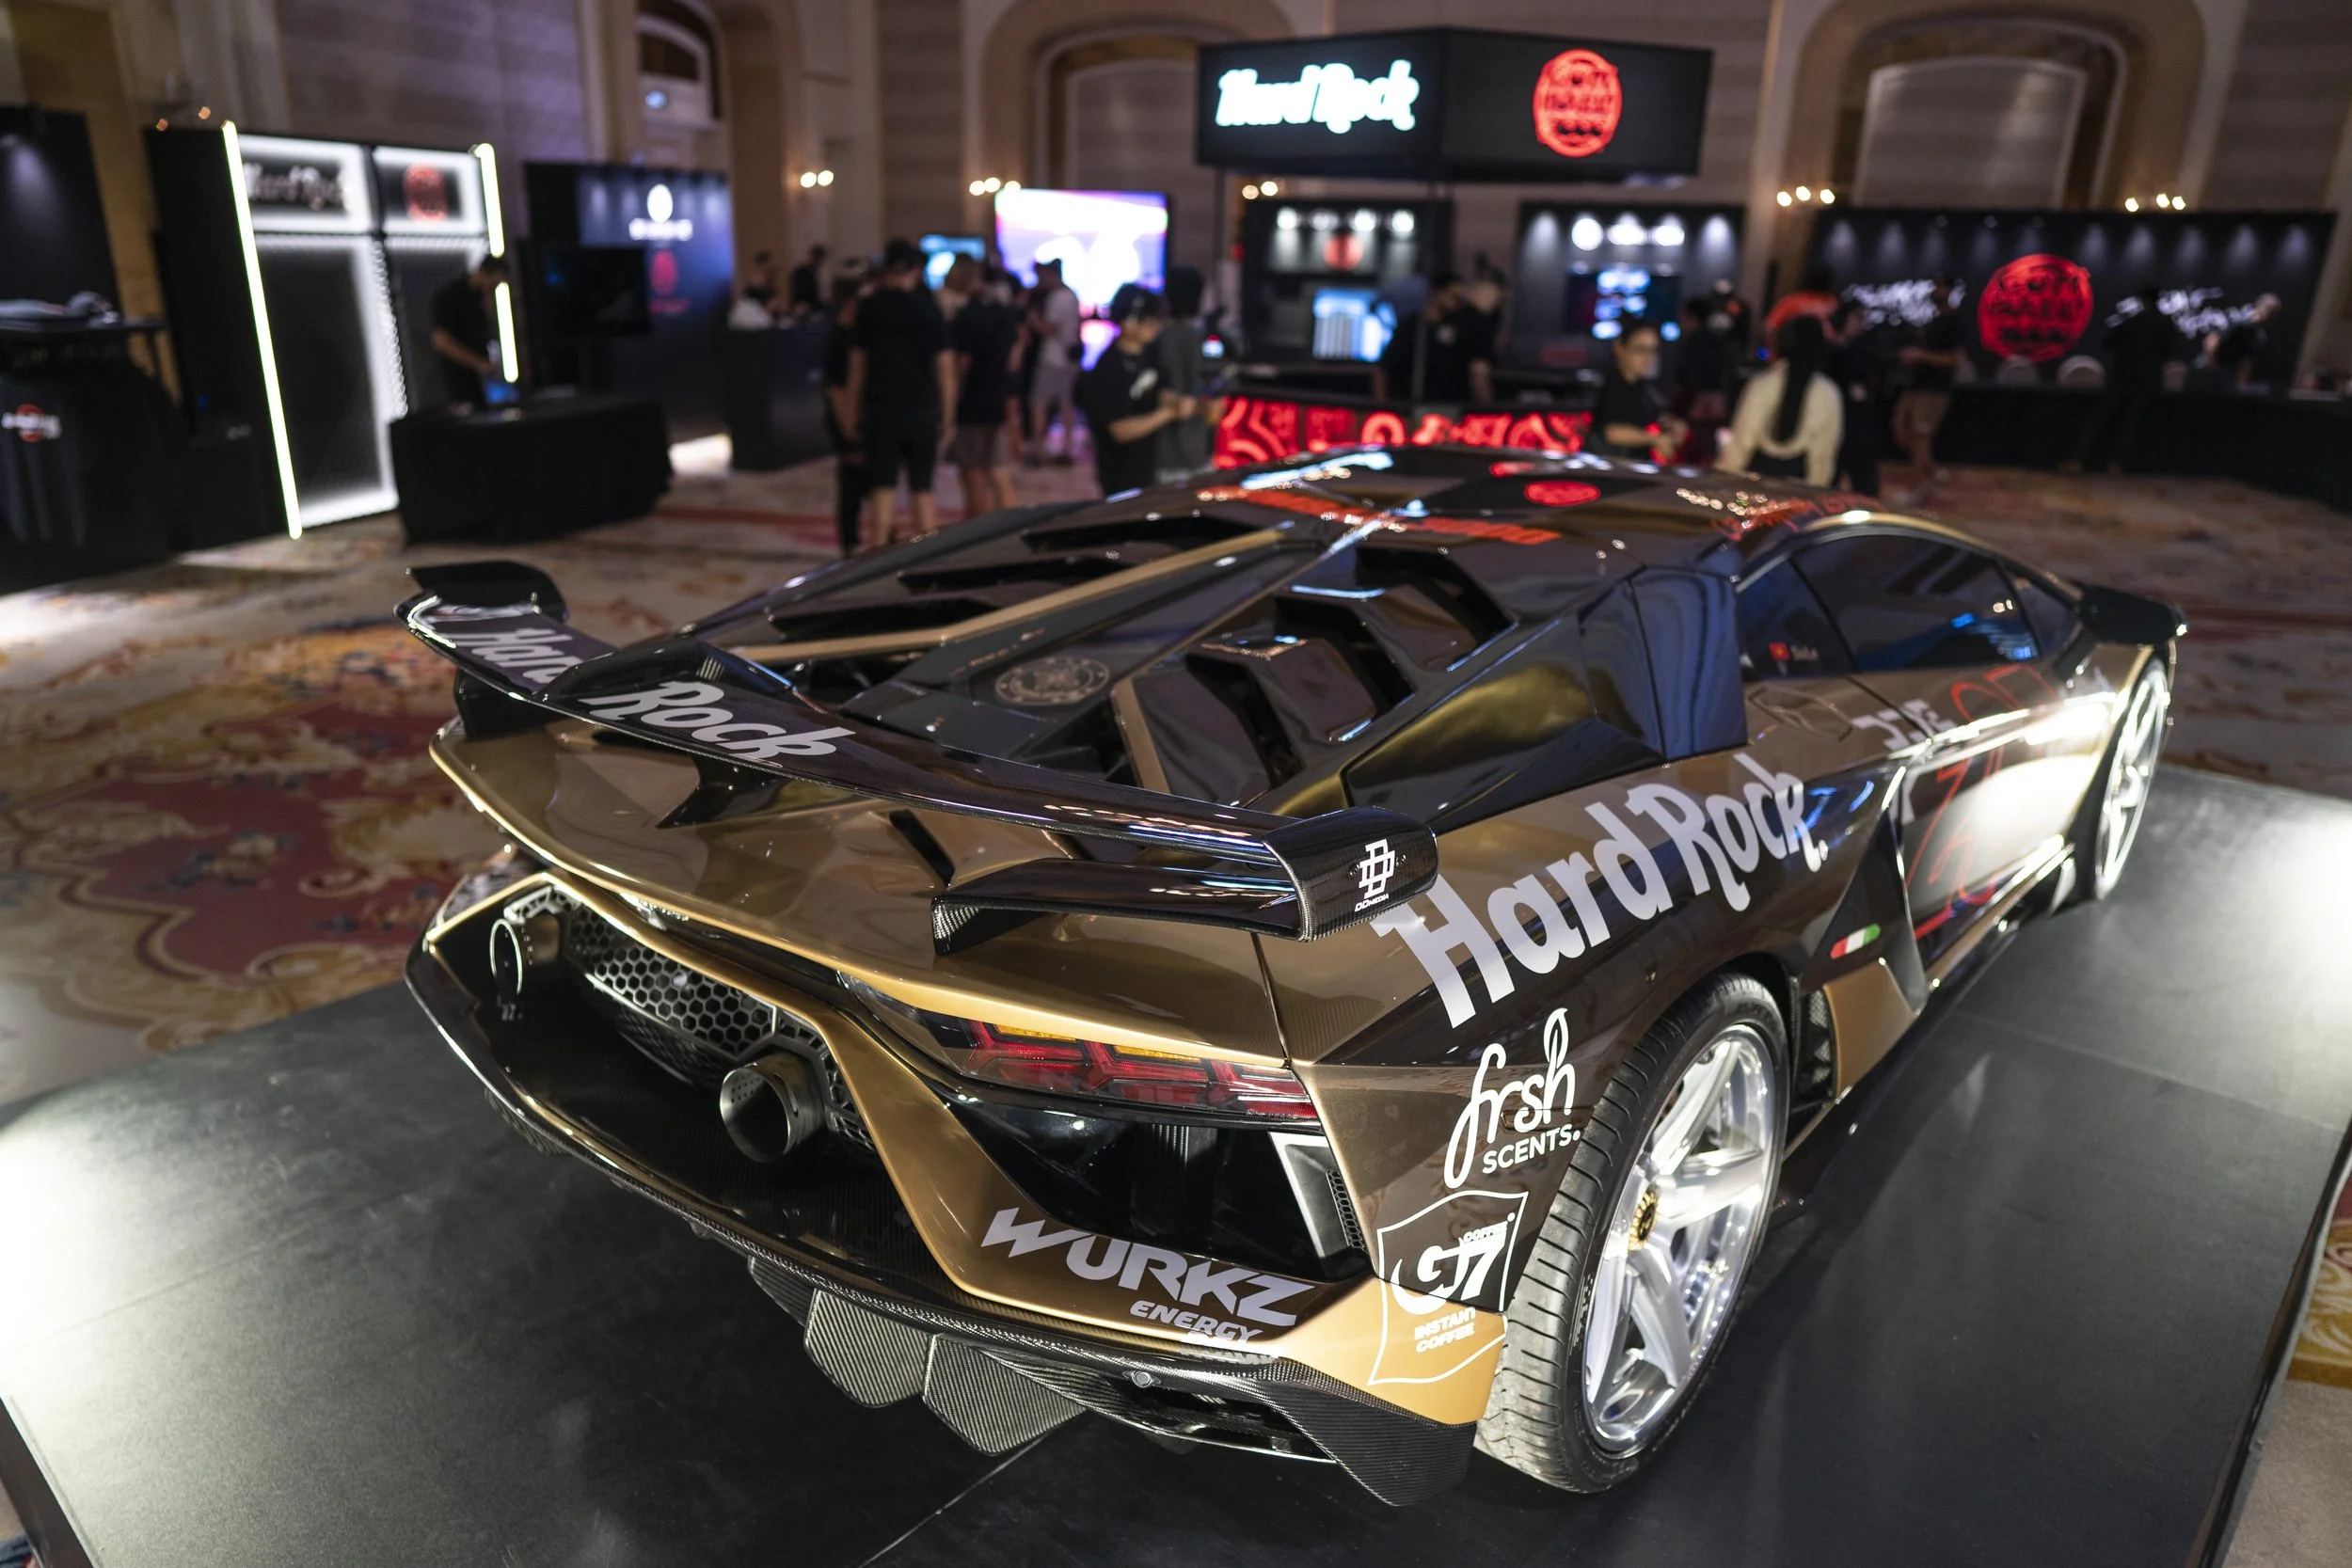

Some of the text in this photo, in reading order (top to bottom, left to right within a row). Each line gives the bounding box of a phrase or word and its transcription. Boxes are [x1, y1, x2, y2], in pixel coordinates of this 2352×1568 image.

[1215, 59, 1420, 134] Hard Rock
[578, 680, 856, 768] Rock
[1370, 753, 1818, 1029] Hard Rock
[1443, 1007, 1576, 1189] frsh
[981, 1207, 1316, 1327] WURKZ
[1130, 1300, 1263, 1344] ENERGY
[1416, 1322, 1475, 1353] COFFEE
